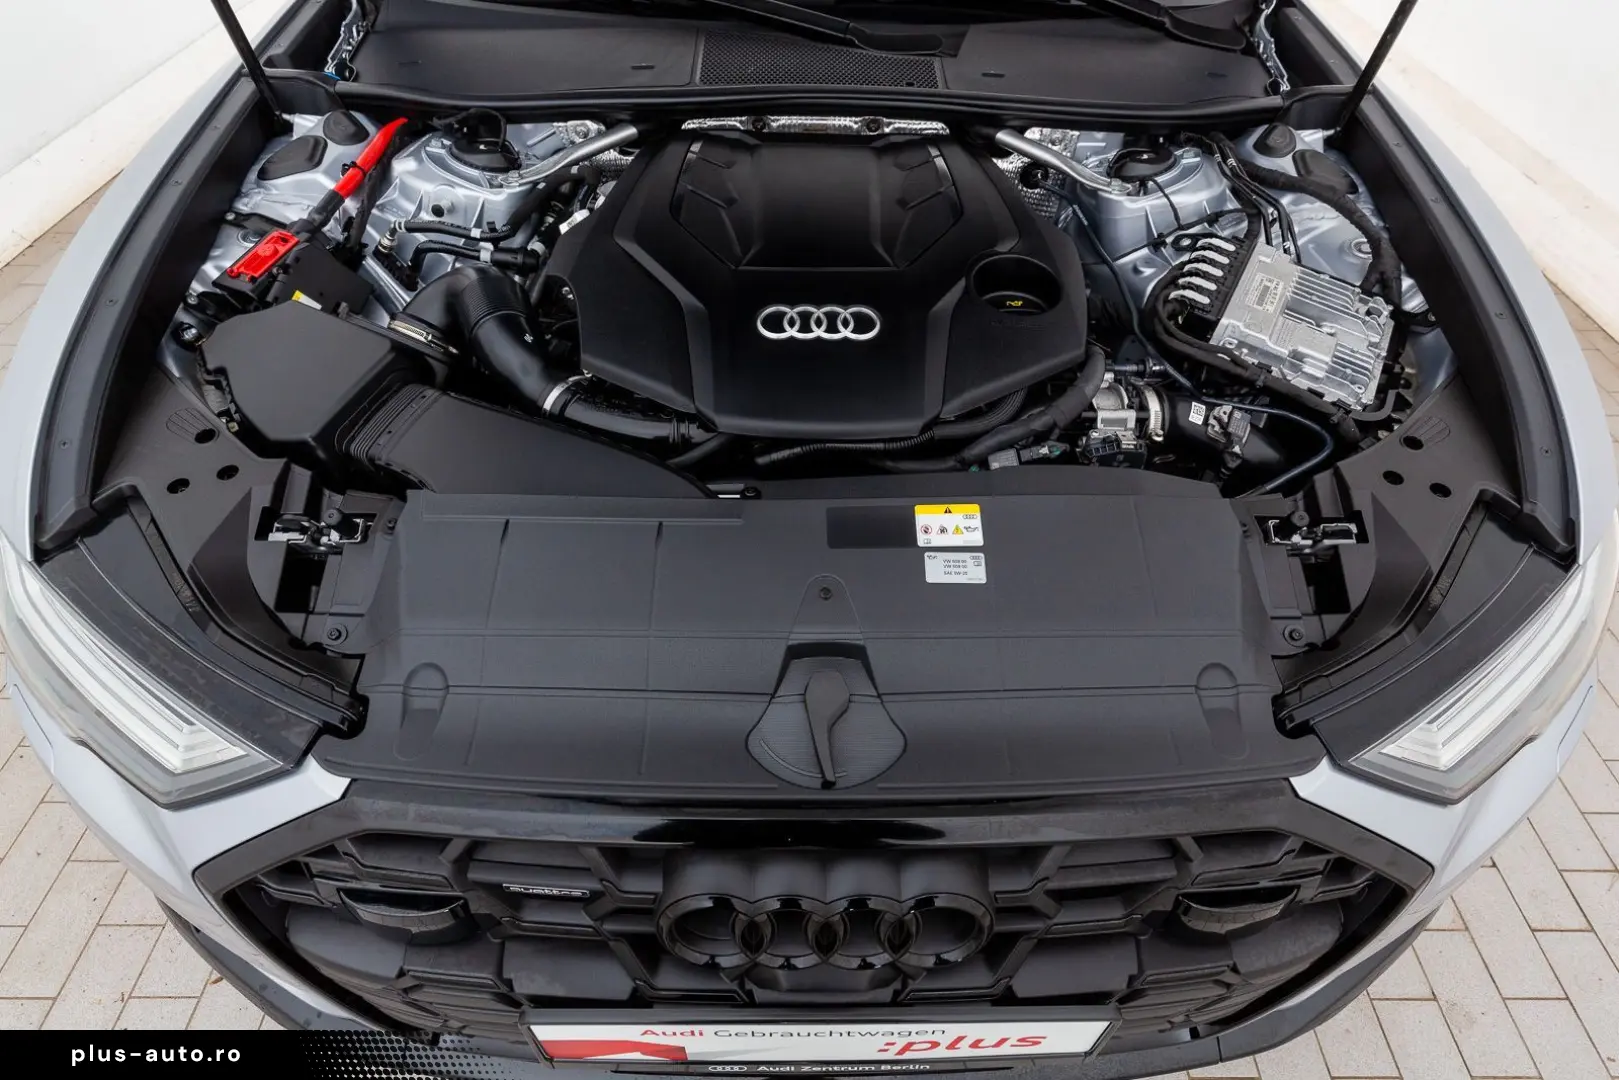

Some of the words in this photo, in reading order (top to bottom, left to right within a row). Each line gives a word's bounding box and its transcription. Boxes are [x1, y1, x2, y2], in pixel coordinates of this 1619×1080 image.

[509, 886, 582, 896] quattro
[640, 1029, 704, 1037] Audi
[714, 1029, 945, 1038] Gebrauchtwagen
